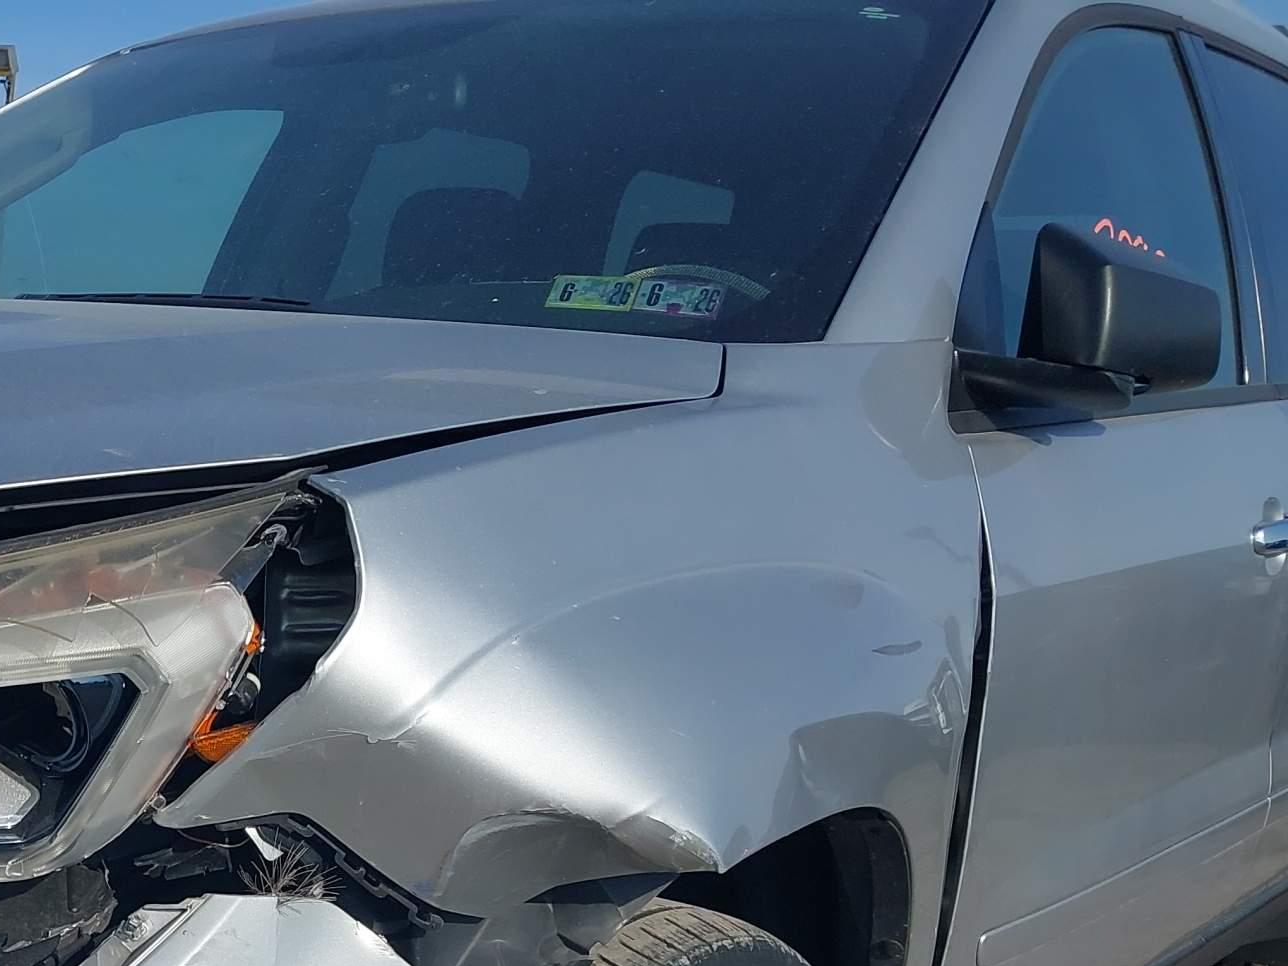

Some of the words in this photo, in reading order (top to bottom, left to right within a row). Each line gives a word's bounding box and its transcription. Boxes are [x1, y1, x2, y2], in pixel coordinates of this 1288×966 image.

[559, 282, 576, 302] 6
[609, 282, 634, 306] 26
[646, 283, 665, 306] 6
